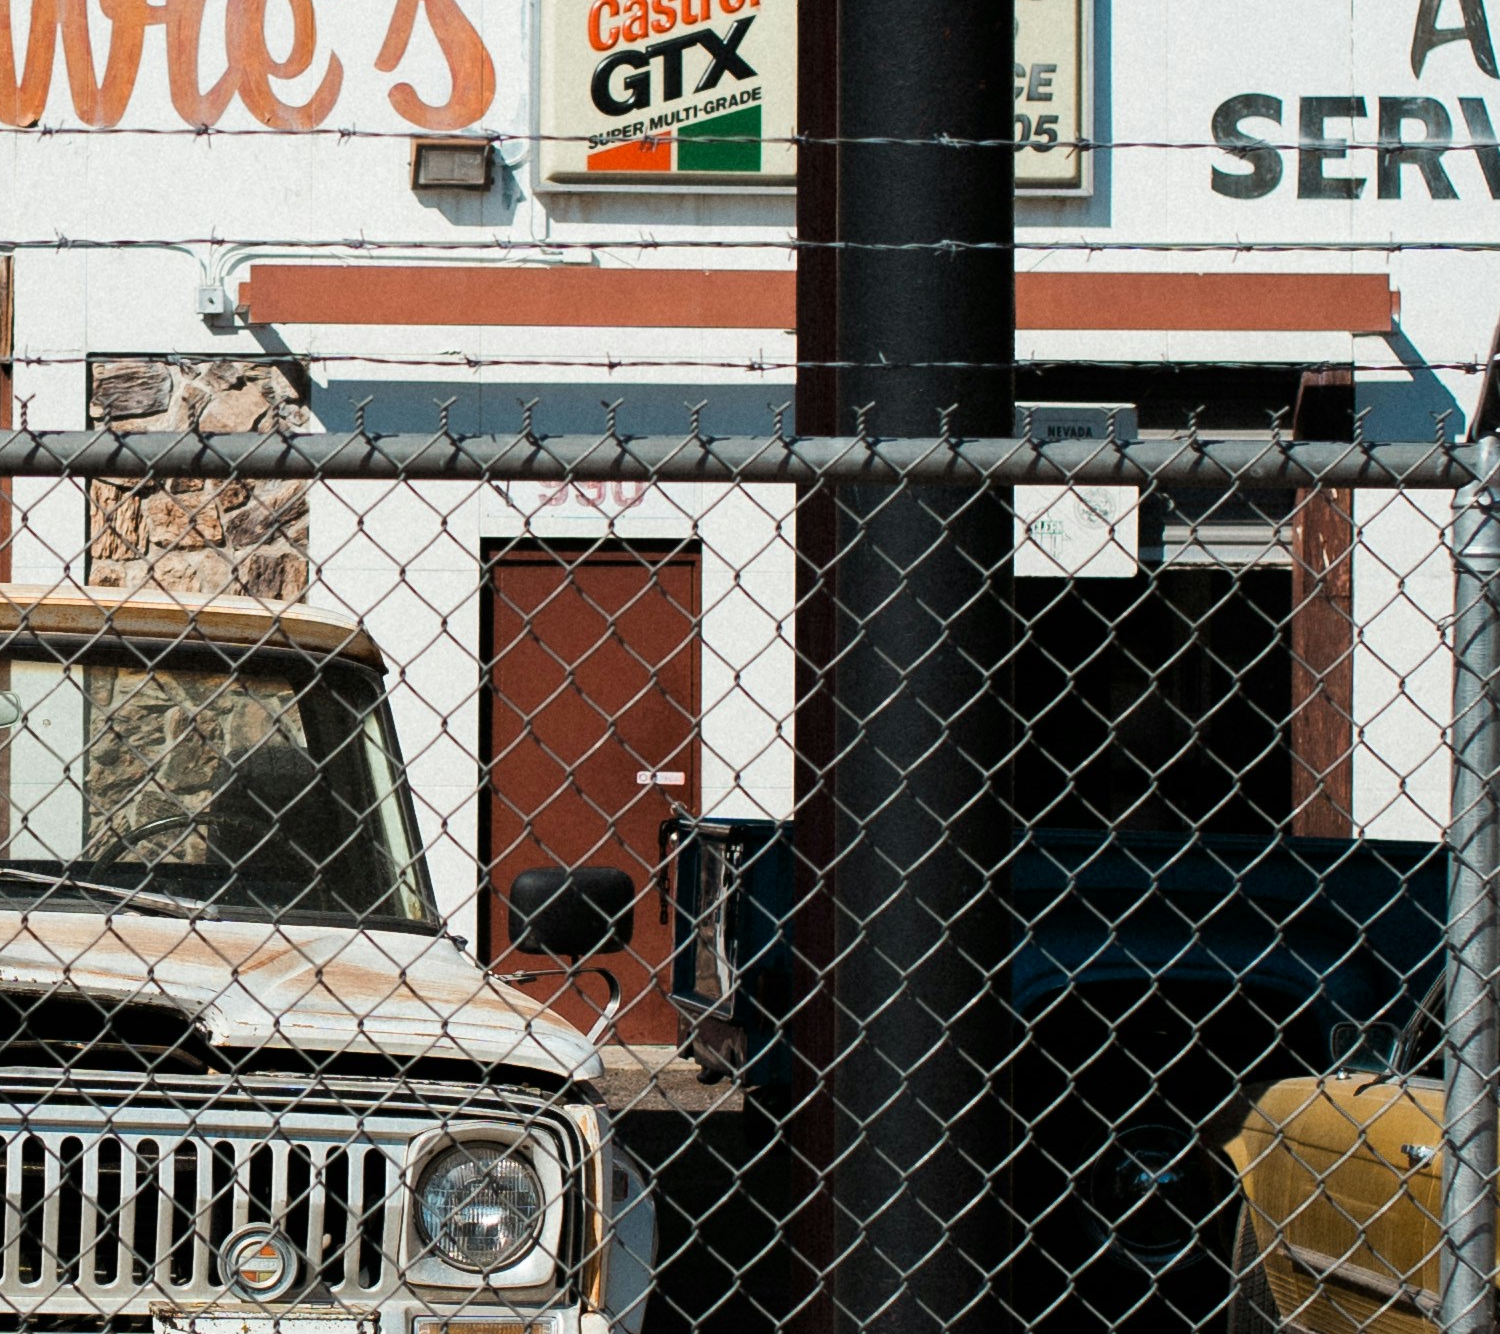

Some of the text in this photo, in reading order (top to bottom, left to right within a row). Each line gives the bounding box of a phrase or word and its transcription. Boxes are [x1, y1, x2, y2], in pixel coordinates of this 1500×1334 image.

[590, 14, 758, 117] GTX
[587, 85, 763, 150] SUPER MULTI-GRADE
[1047, 425, 1094, 438] NEVADA
